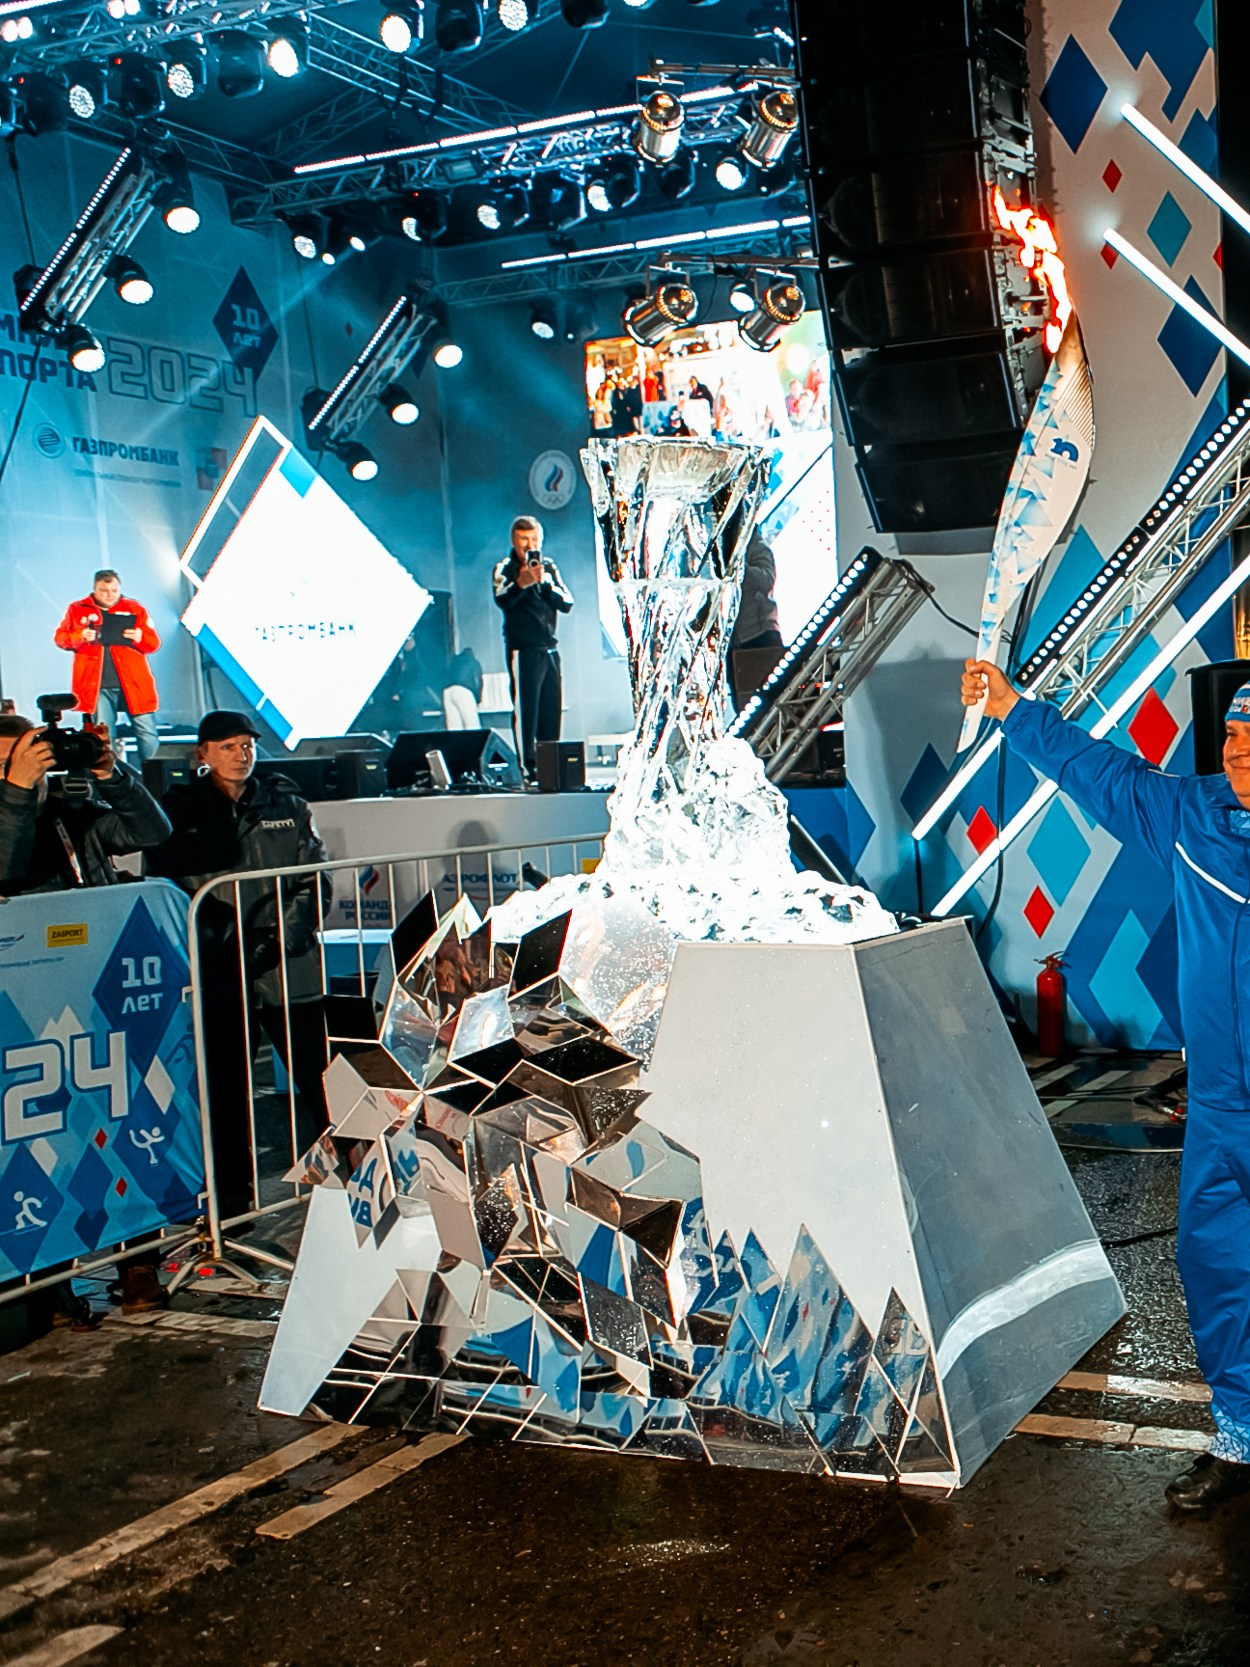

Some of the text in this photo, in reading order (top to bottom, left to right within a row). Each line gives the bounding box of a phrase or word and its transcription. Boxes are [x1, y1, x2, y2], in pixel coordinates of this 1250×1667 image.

[231, 303, 260, 330] 10
[106, 336, 258, 417] 2024
[72, 436, 180, 466] ГАЗПРОМБАНК
[339, 900, 394, 910] КОАНД
[345, 911, 390, 920] РССИИ
[121, 956, 162, 988] 10
[2, 1030, 131, 1142] 24
